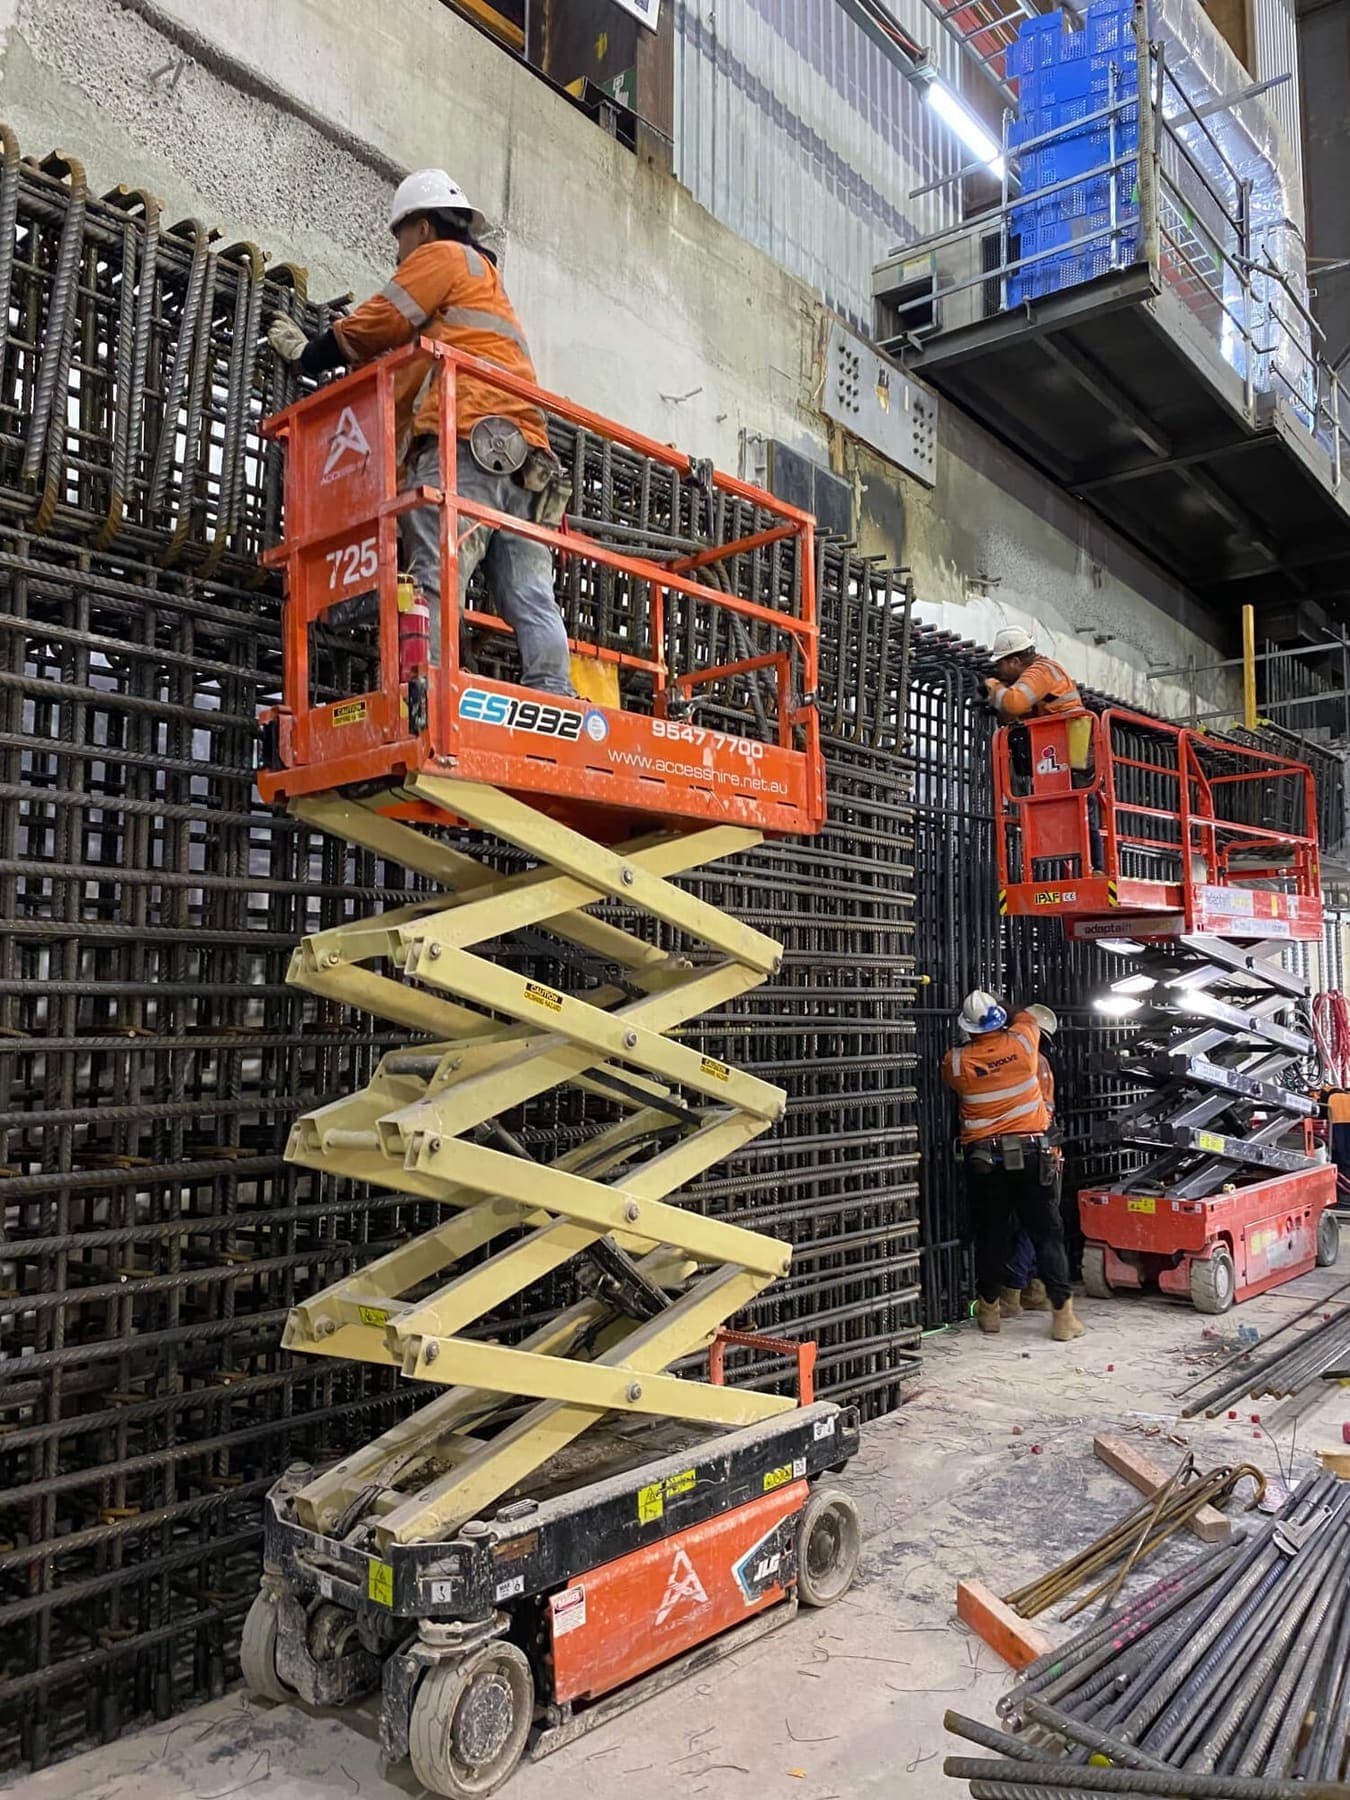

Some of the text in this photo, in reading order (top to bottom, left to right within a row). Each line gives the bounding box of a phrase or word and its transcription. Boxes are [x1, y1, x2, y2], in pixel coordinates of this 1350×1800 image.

[326, 536, 378, 589] 725
[459, 690, 582, 739] ES1932
[652, 720, 763, 758] 9547 7700
[607, 749, 788, 795] www.accesshire.net.au
[1035, 890, 1060, 903] IPAF
[530, 984, 559, 1002] CAUTION
[987, 1053, 1018, 1069] EVOLVE
[753, 1551, 781, 1582] JLG
